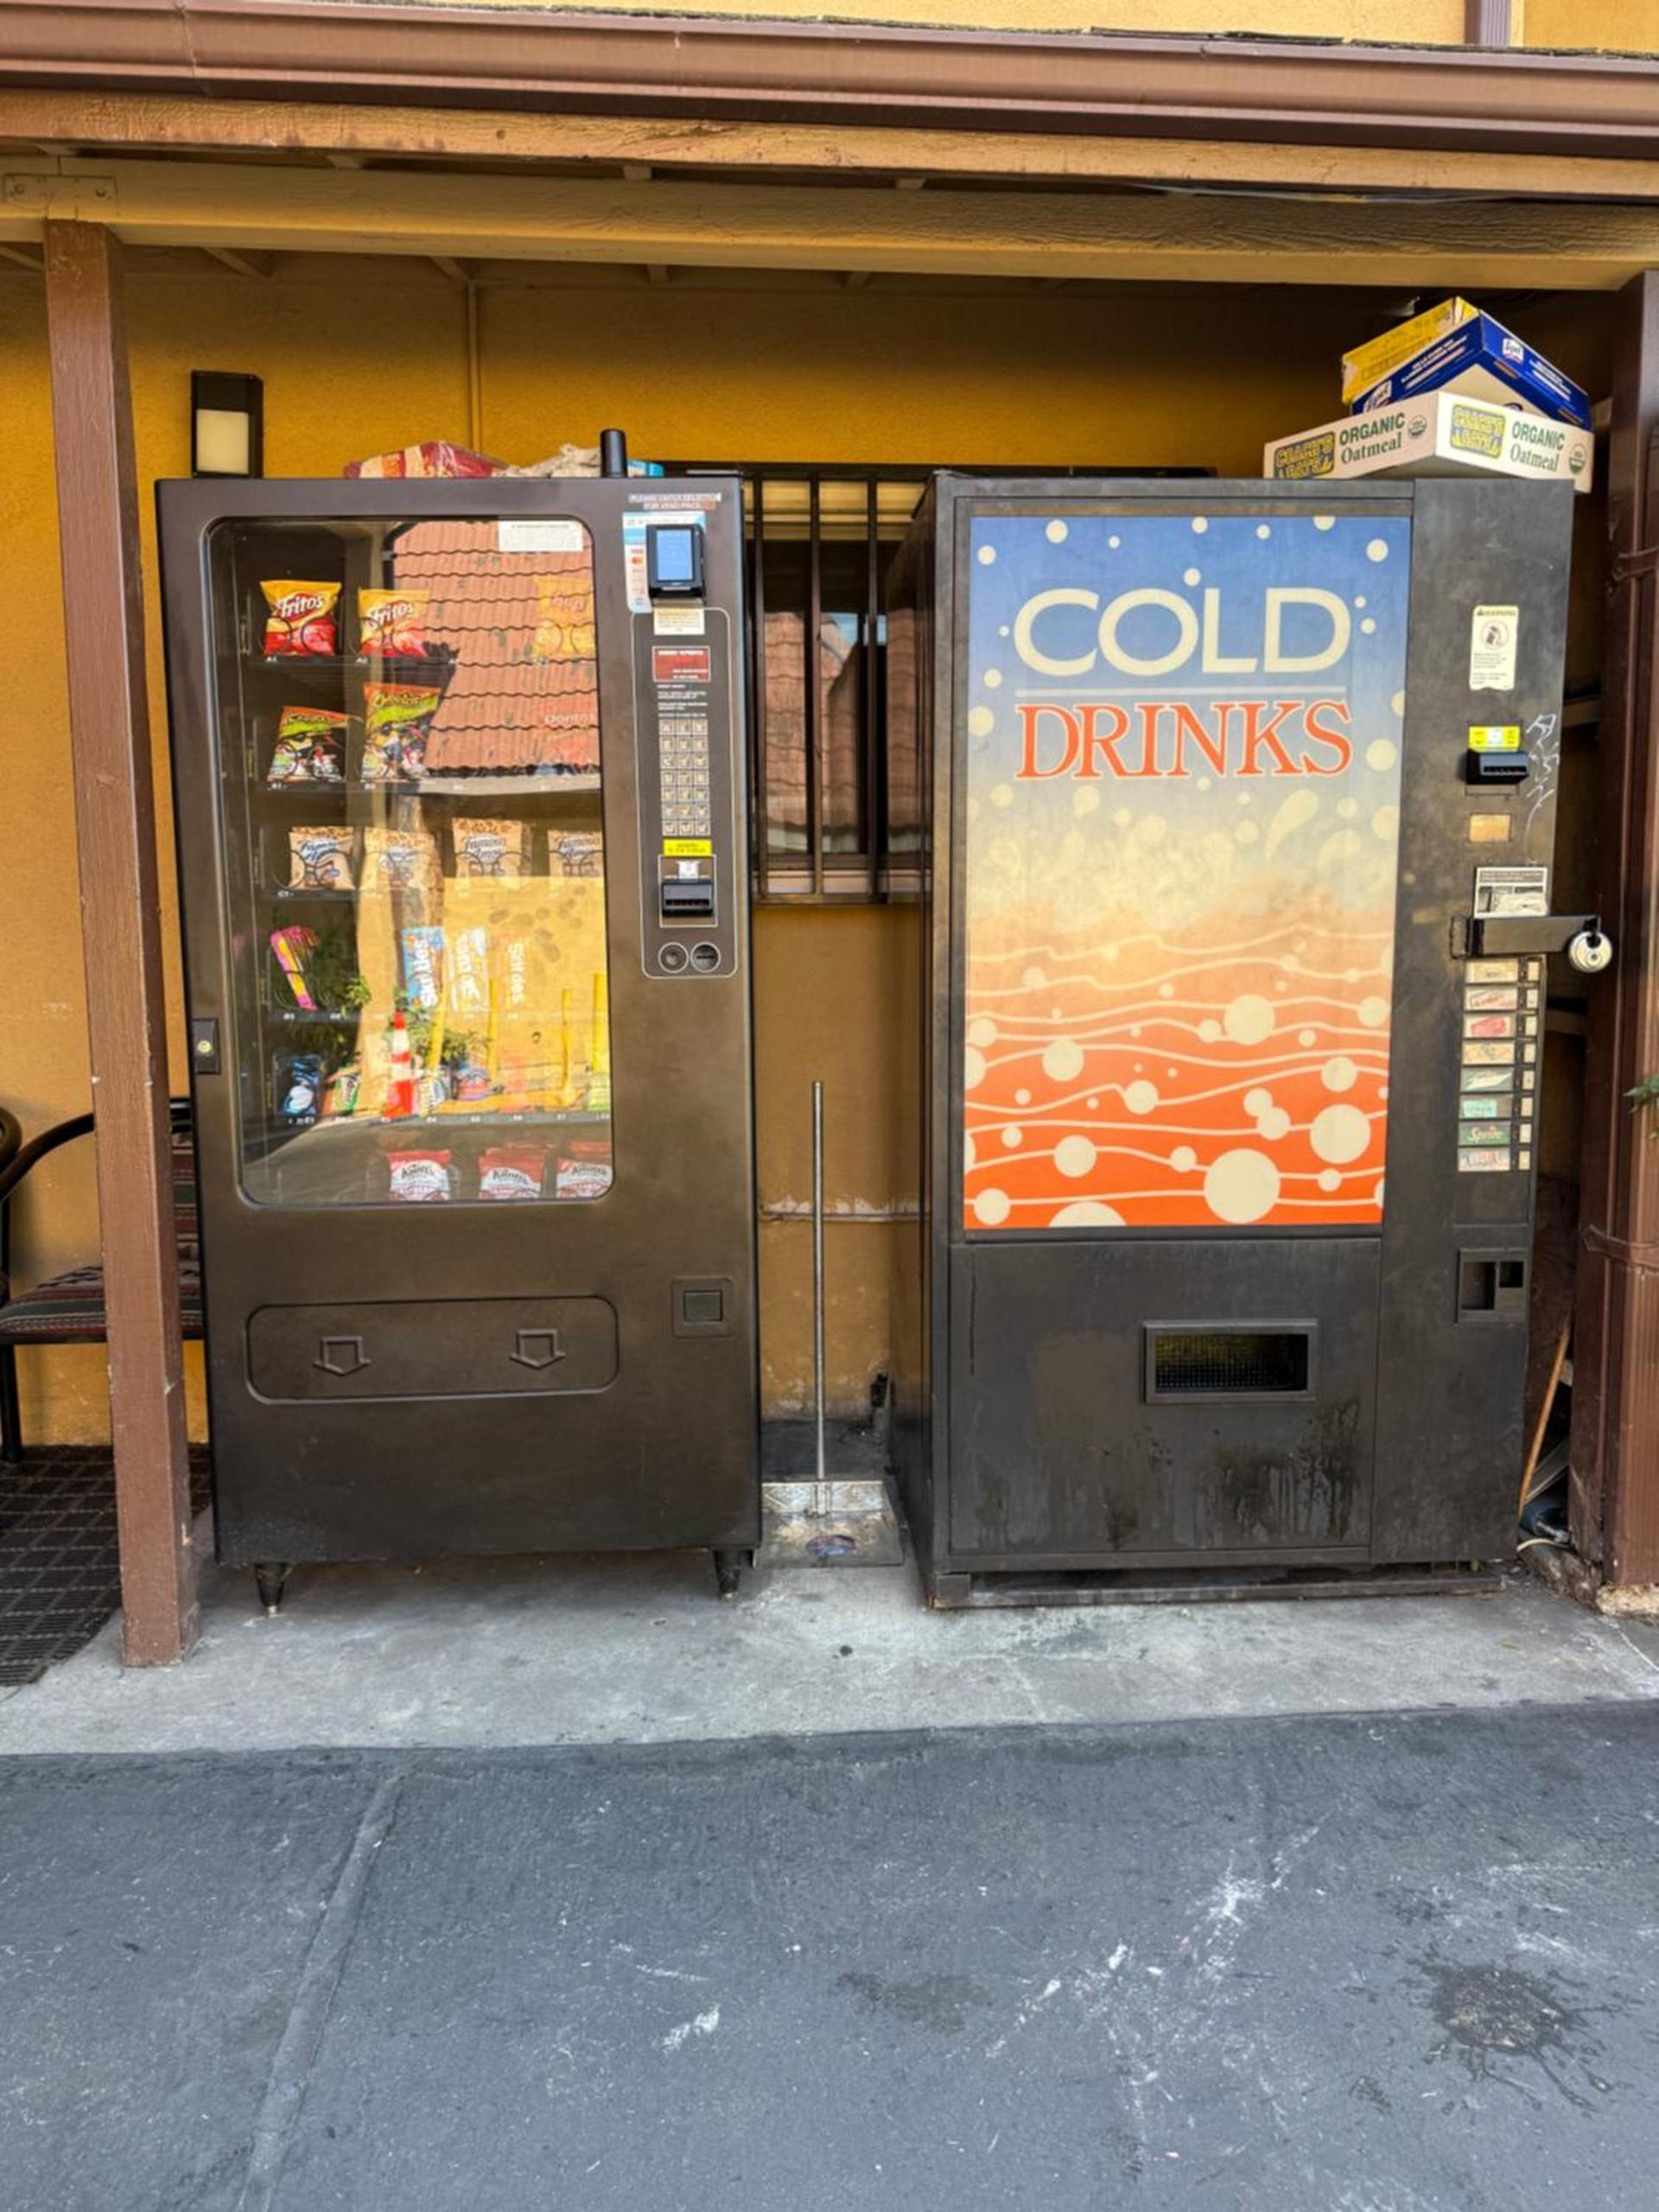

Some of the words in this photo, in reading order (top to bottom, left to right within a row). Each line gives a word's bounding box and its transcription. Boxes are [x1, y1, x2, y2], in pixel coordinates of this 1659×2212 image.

[1339, 411, 1406, 448] ORGANIC
[1511, 421, 1566, 450] ORGANIC
[1341, 433, 1402, 466] Oatmeal
[1510, 444, 1559, 473] Oatmeal
[276, 595, 324, 618] Fritos
[368, 603, 413, 626] Fritos
[1014, 588, 1351, 676] COLD
[1014, 699, 1354, 779] DRINKS
